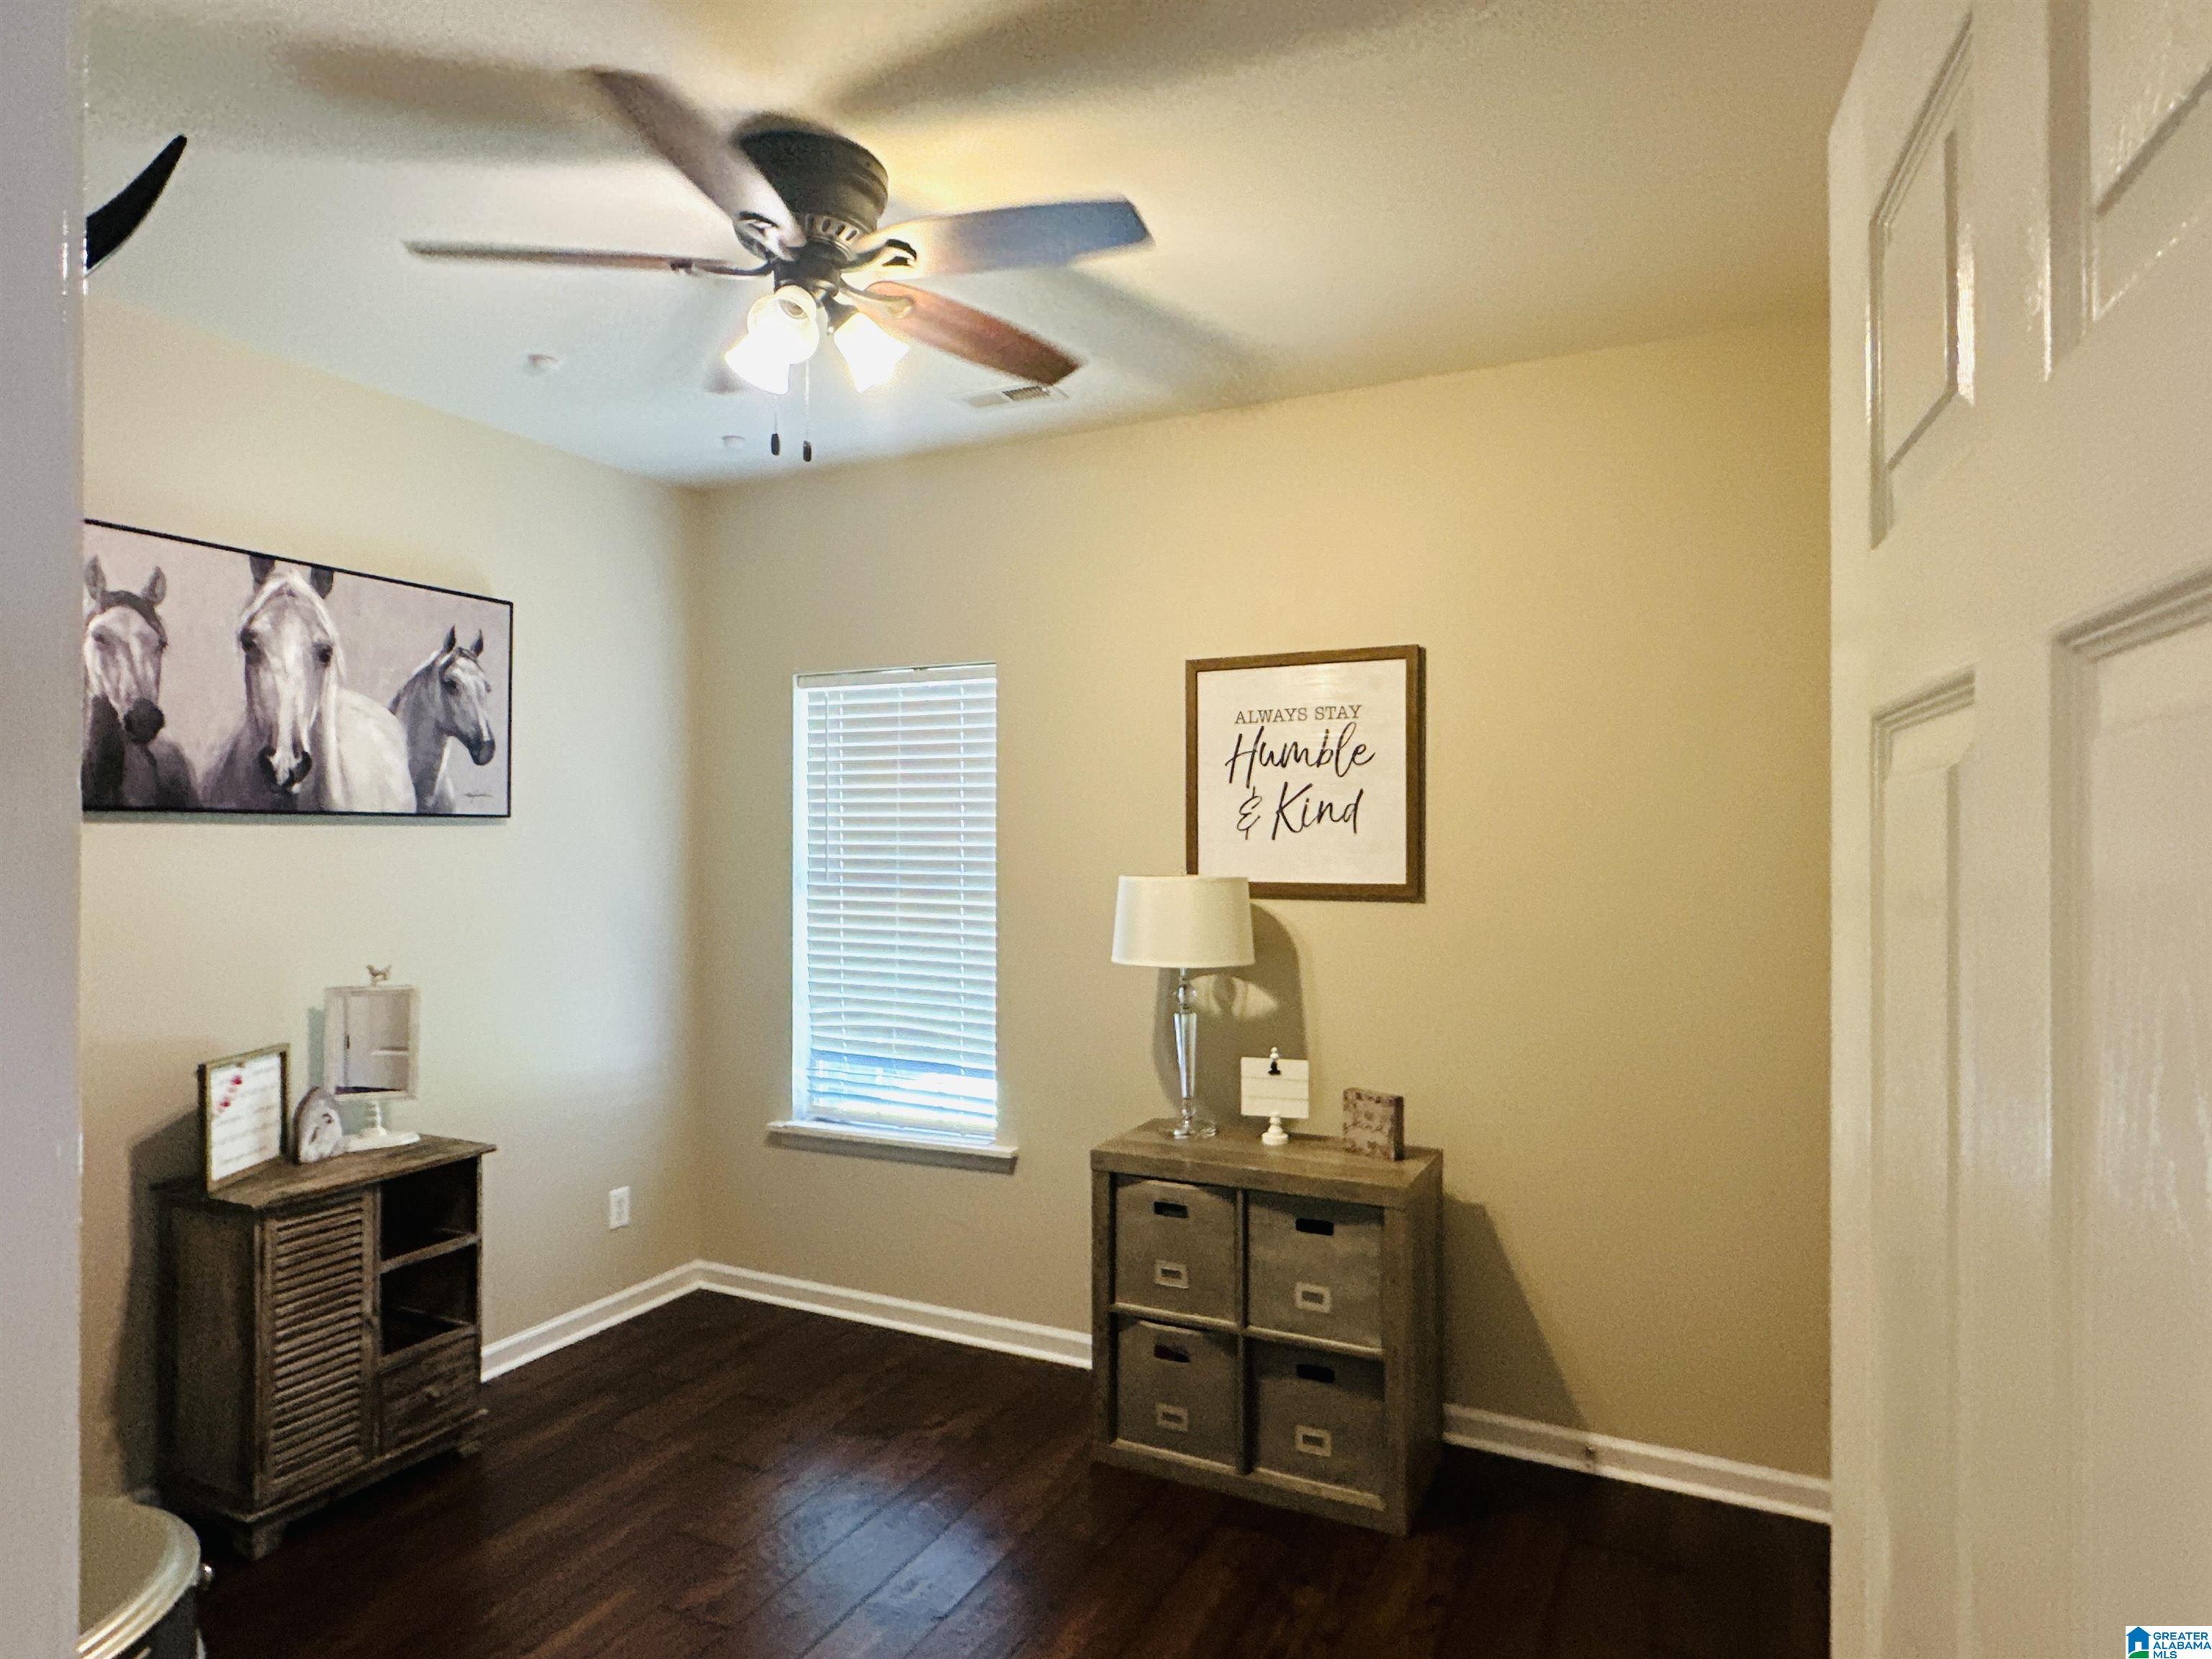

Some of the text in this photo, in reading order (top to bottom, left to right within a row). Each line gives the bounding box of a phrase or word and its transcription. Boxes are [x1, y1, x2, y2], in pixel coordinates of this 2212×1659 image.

[1234, 705, 1362, 724] ALWAYS STAY
[1225, 721, 1376, 788] Humble
[1236, 781, 1363, 840] & Kind
